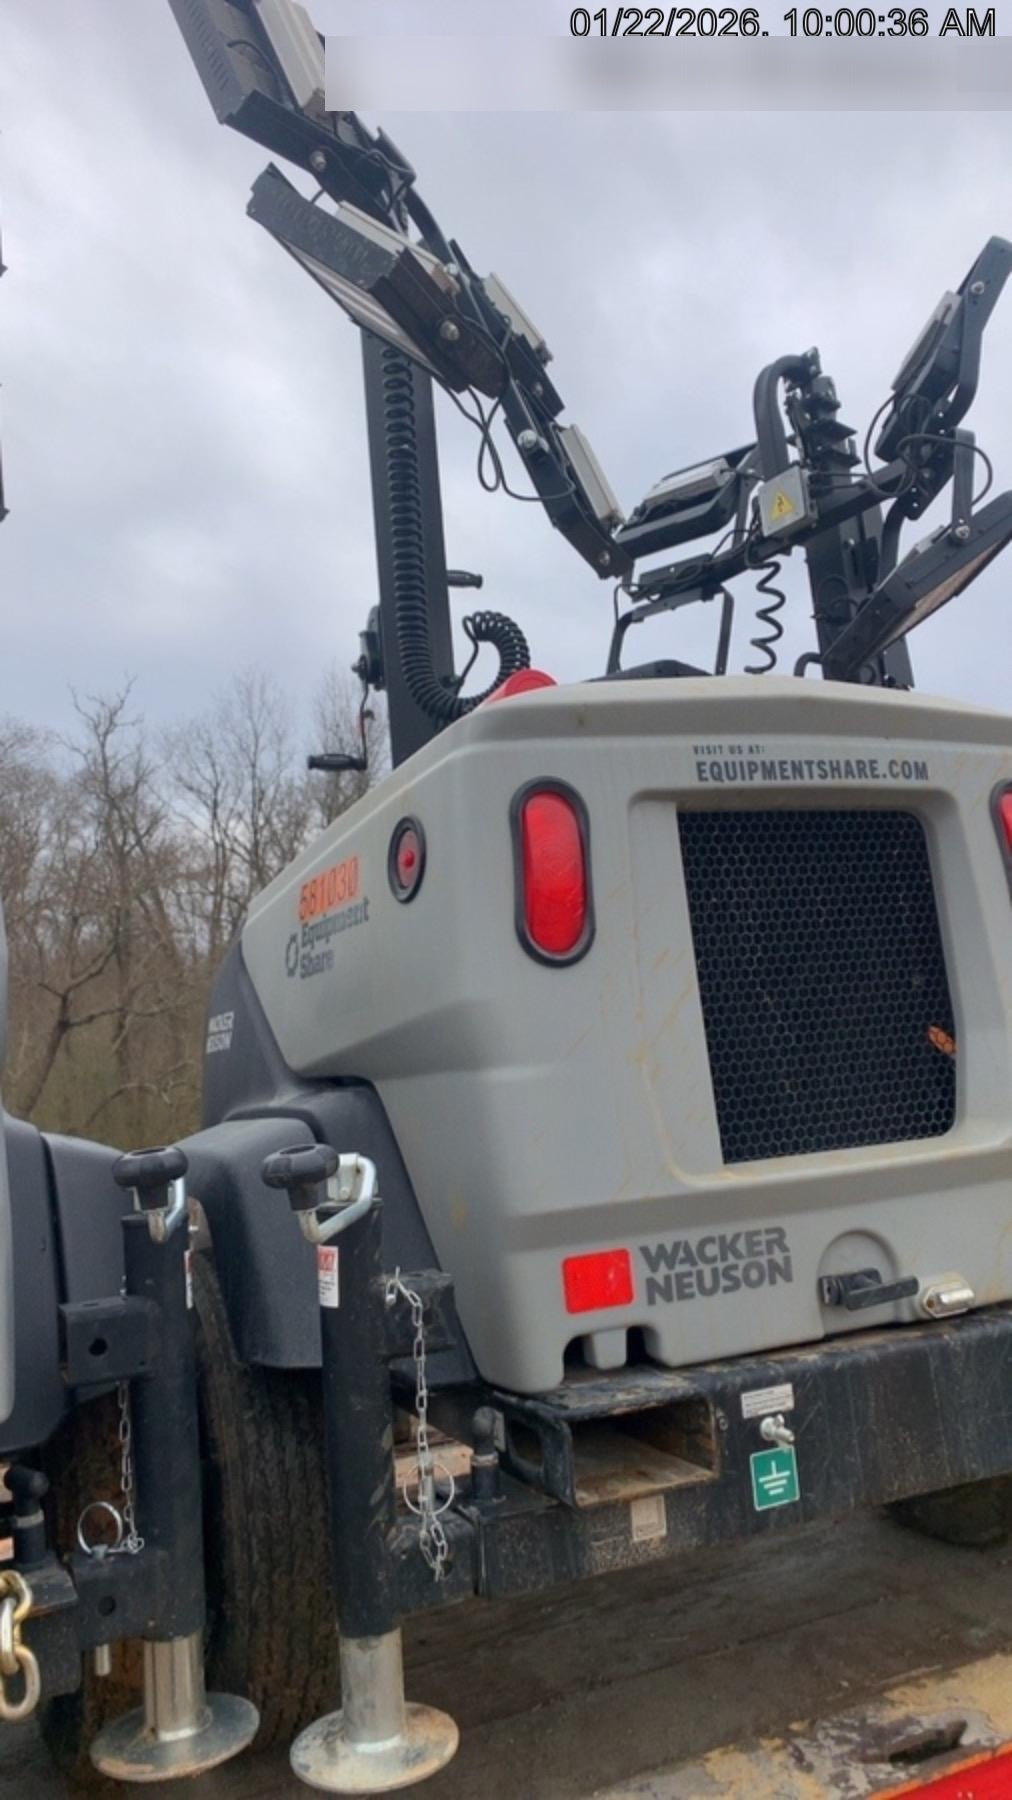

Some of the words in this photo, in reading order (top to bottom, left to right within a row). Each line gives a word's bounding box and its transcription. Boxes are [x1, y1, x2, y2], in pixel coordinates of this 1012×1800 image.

[693, 744, 724, 756] VISIT
[728, 744, 744, 756] US
[696, 759, 930, 783] EQUIPMENTSHARE.COM
[301, 896, 370, 949] Equipment
[299, 949, 335, 979] Share
[639, 1226, 792, 1273] WACKER
[645, 1255, 794, 1306] NEUSON
